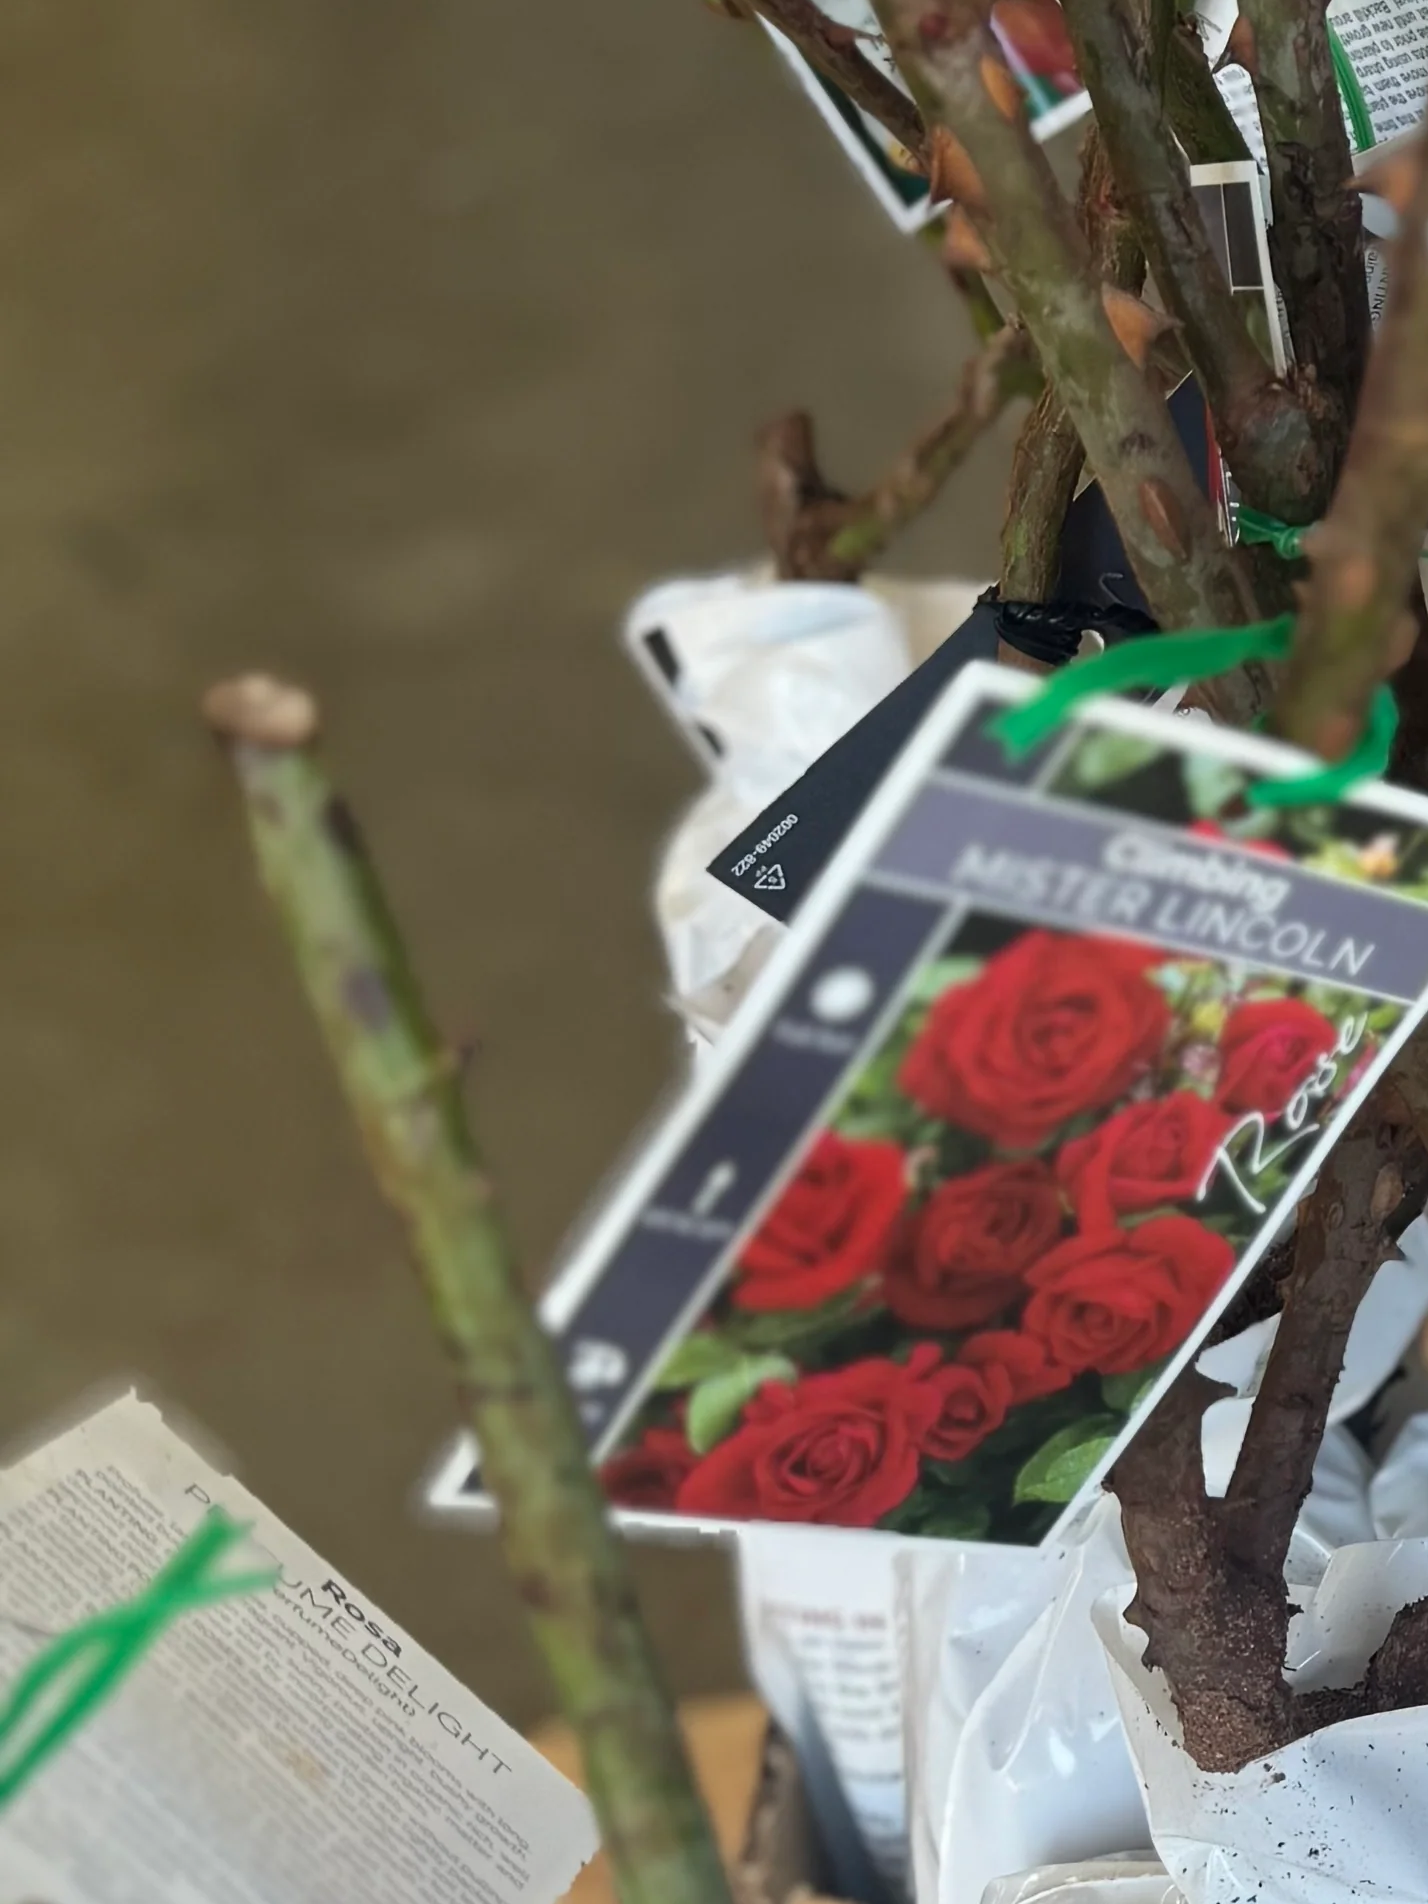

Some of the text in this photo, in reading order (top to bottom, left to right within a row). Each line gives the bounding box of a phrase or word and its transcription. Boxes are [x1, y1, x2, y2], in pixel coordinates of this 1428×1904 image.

[949, 843, 1377, 977] MISTER LINCOLN
[1099, 827, 1290, 915] Climbing
[1195, 1010, 1367, 1213] Rose
[318, 1574, 407, 1660] Rosa
[357, 1638, 515, 1784] DELIGHT
